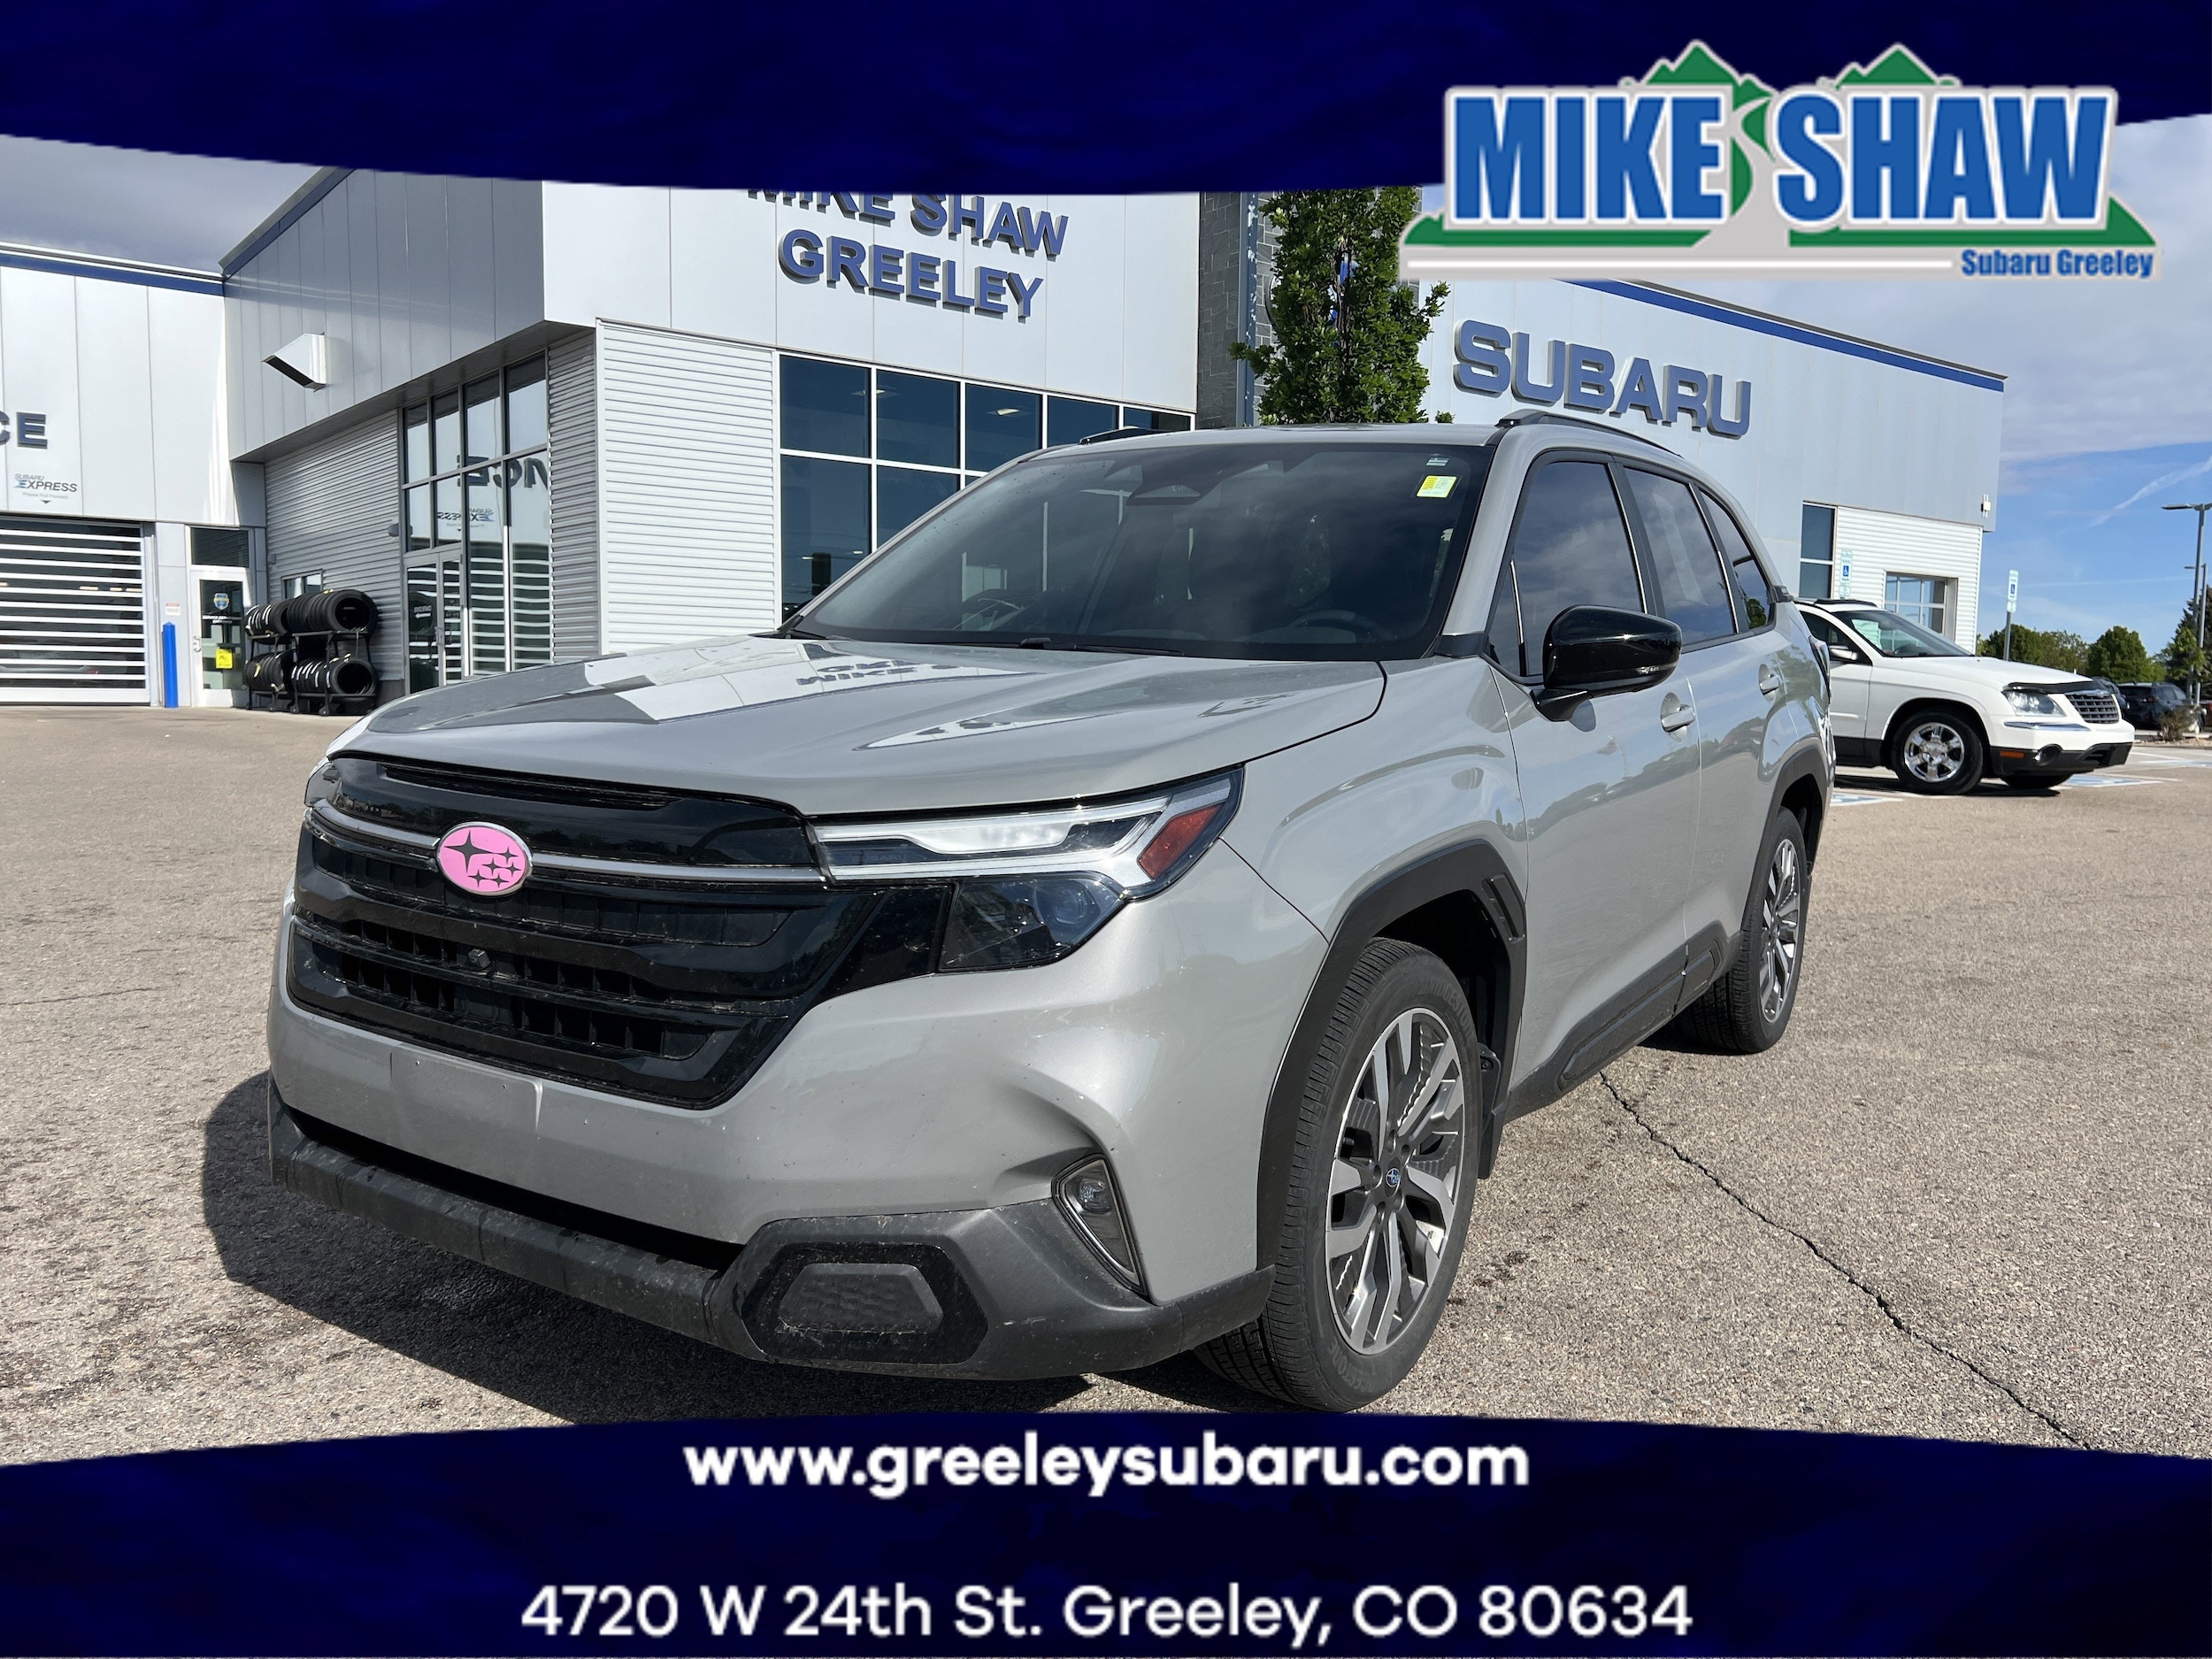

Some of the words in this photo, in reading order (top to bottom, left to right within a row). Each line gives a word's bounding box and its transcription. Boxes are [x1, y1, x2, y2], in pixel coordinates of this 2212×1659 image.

[910, 194, 1069, 259] SHAW
[779, 228, 1044, 320] GREELEY
[1454, 319, 1751, 439] SUBARU
[14, 480, 78, 493] EXPRESS
